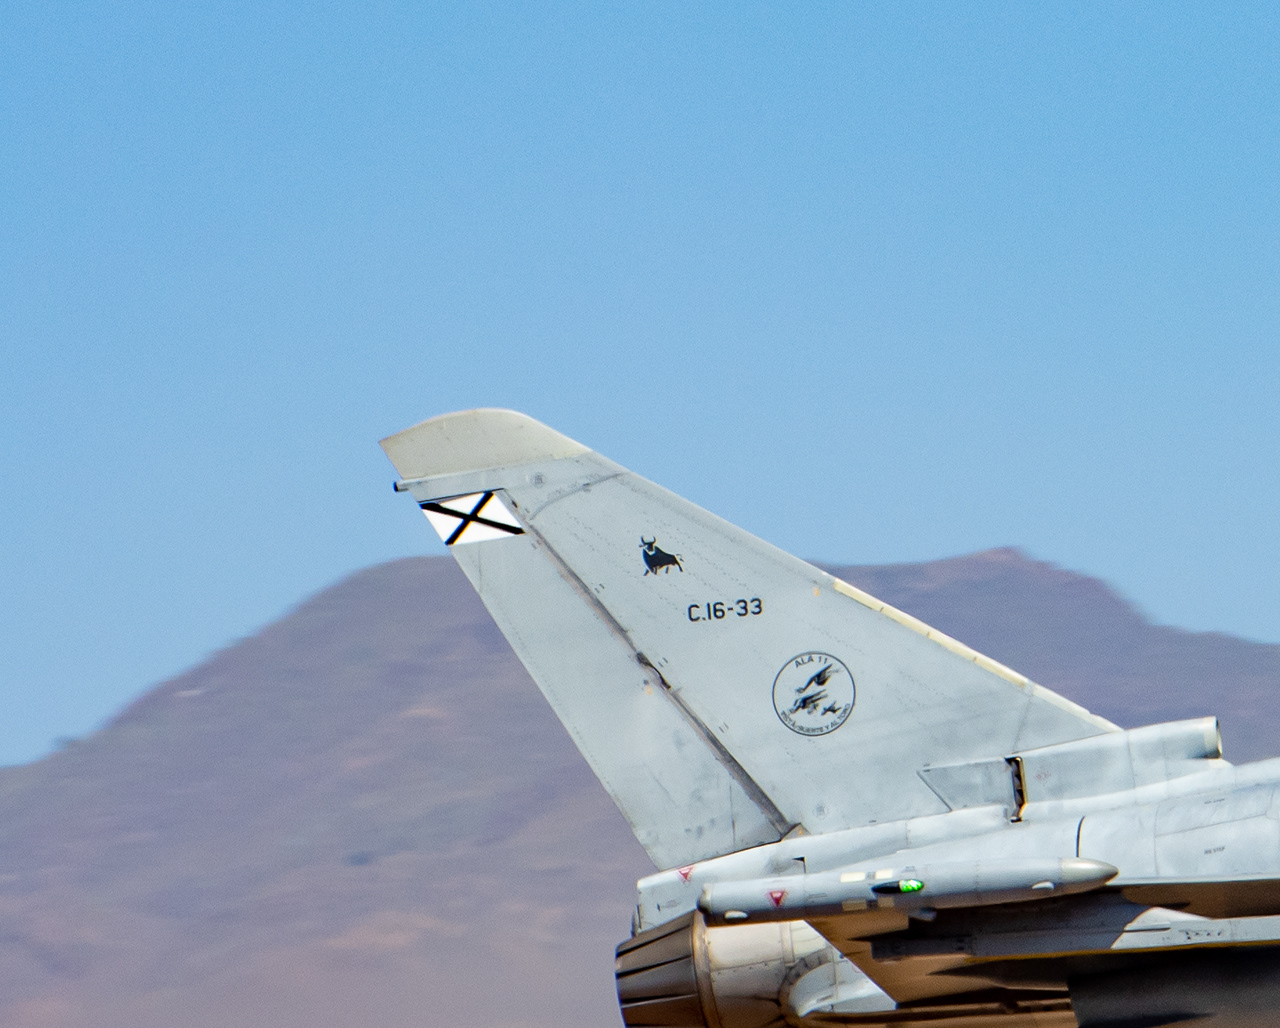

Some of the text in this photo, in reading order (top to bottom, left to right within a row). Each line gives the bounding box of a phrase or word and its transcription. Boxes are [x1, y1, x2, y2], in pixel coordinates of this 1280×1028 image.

[687, 597, 763, 622] C.16-33
[795, 655, 828, 668] ALA 11
